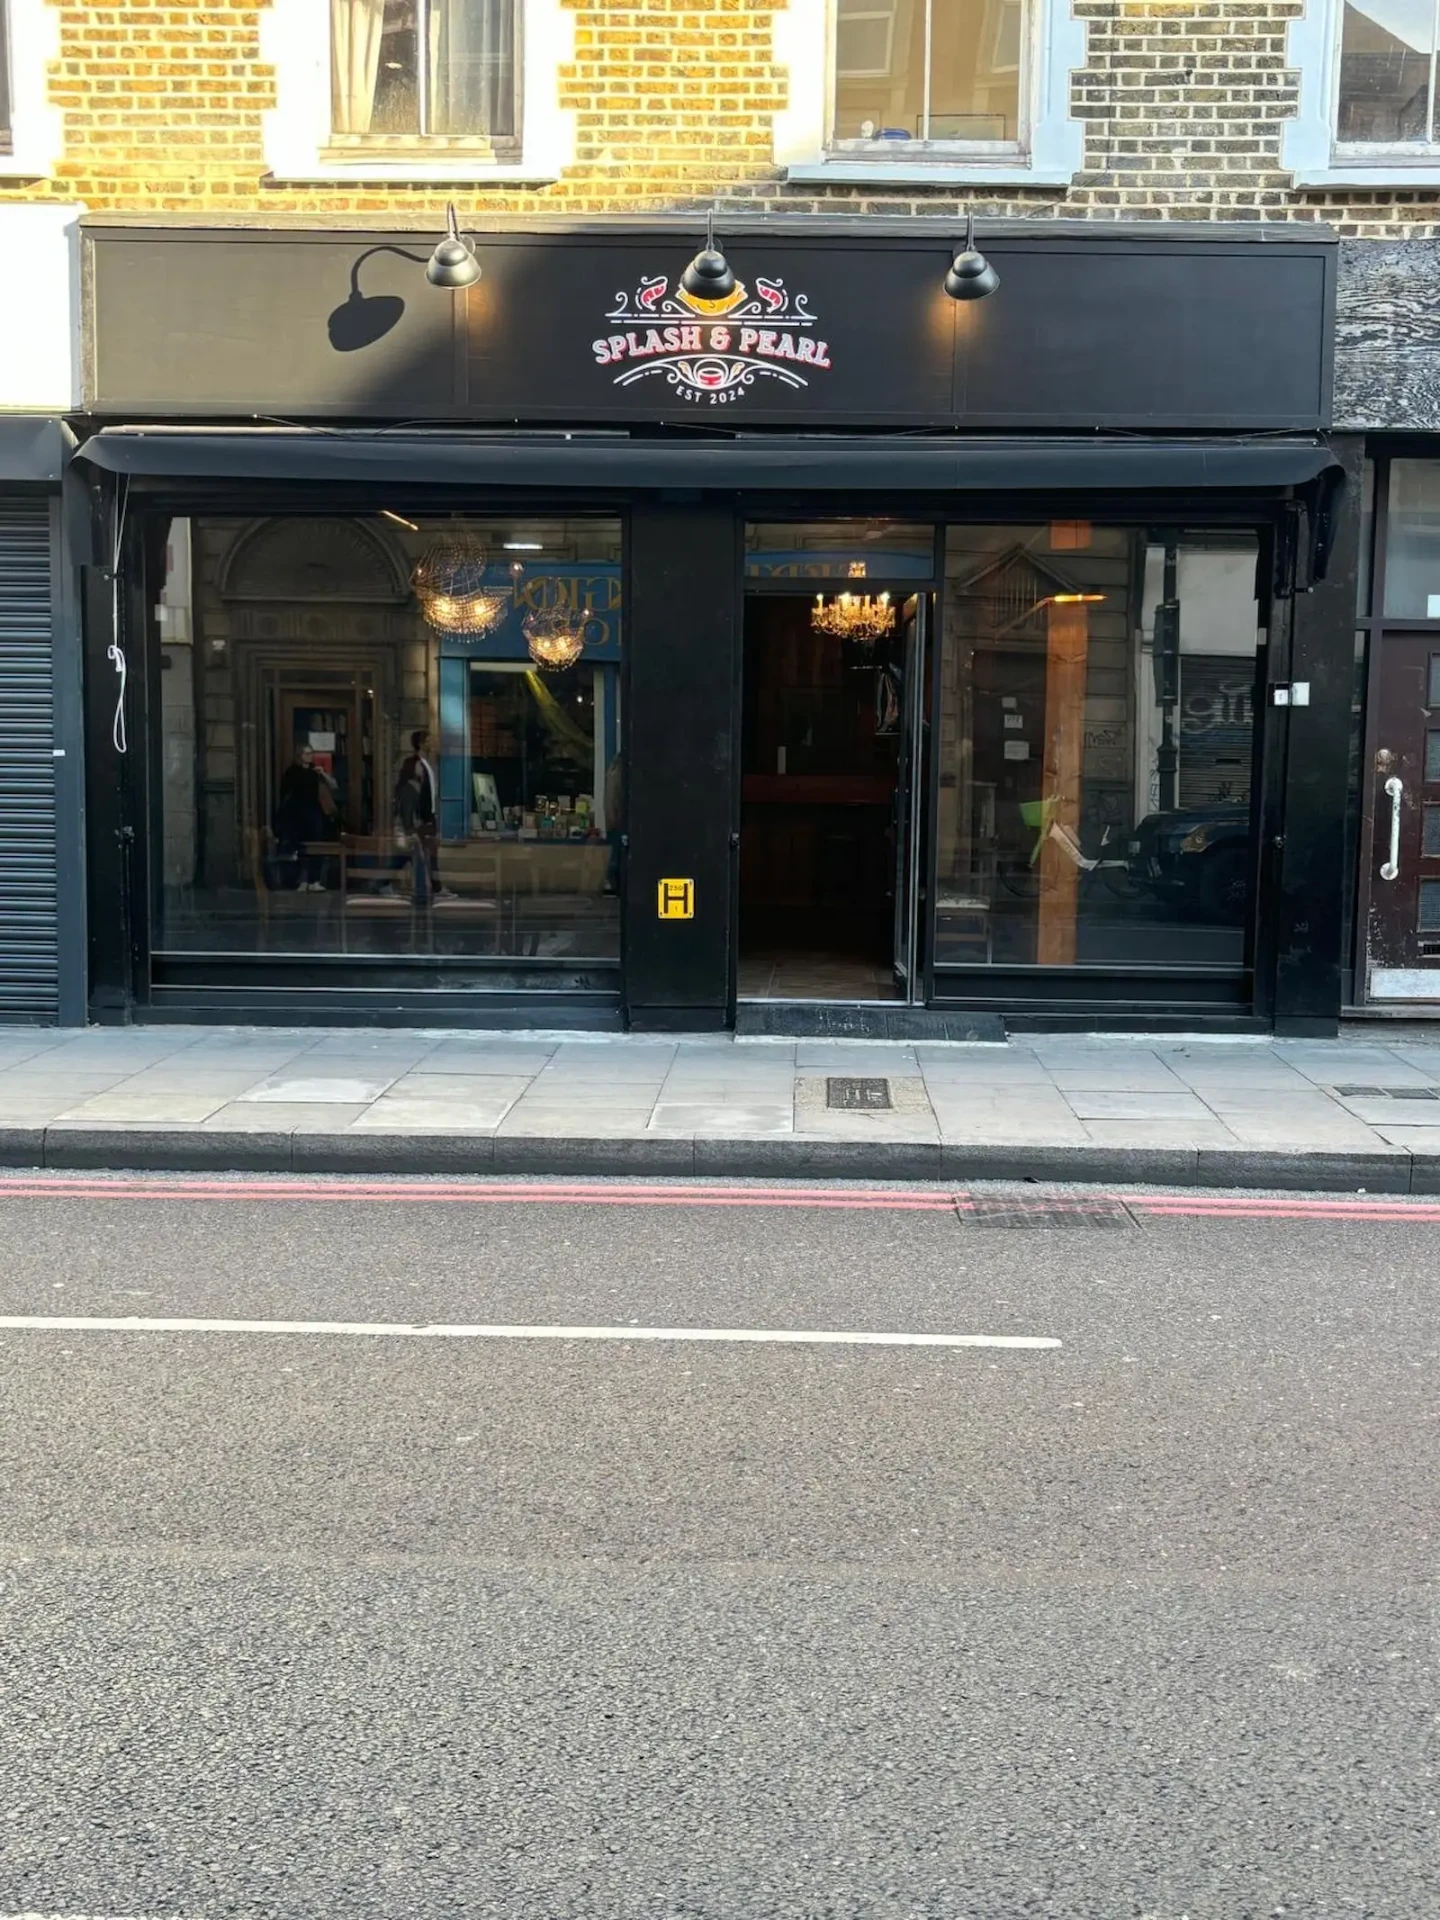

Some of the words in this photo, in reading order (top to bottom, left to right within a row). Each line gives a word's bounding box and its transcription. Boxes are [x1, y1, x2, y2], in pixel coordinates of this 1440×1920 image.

[592, 326, 703, 364] SPLASH
[710, 326, 731, 352] &
[739, 328, 831, 369] PEARL
[676, 385, 702, 403] EST
[709, 386, 745, 404] 2024
[663, 883, 689, 914] H
